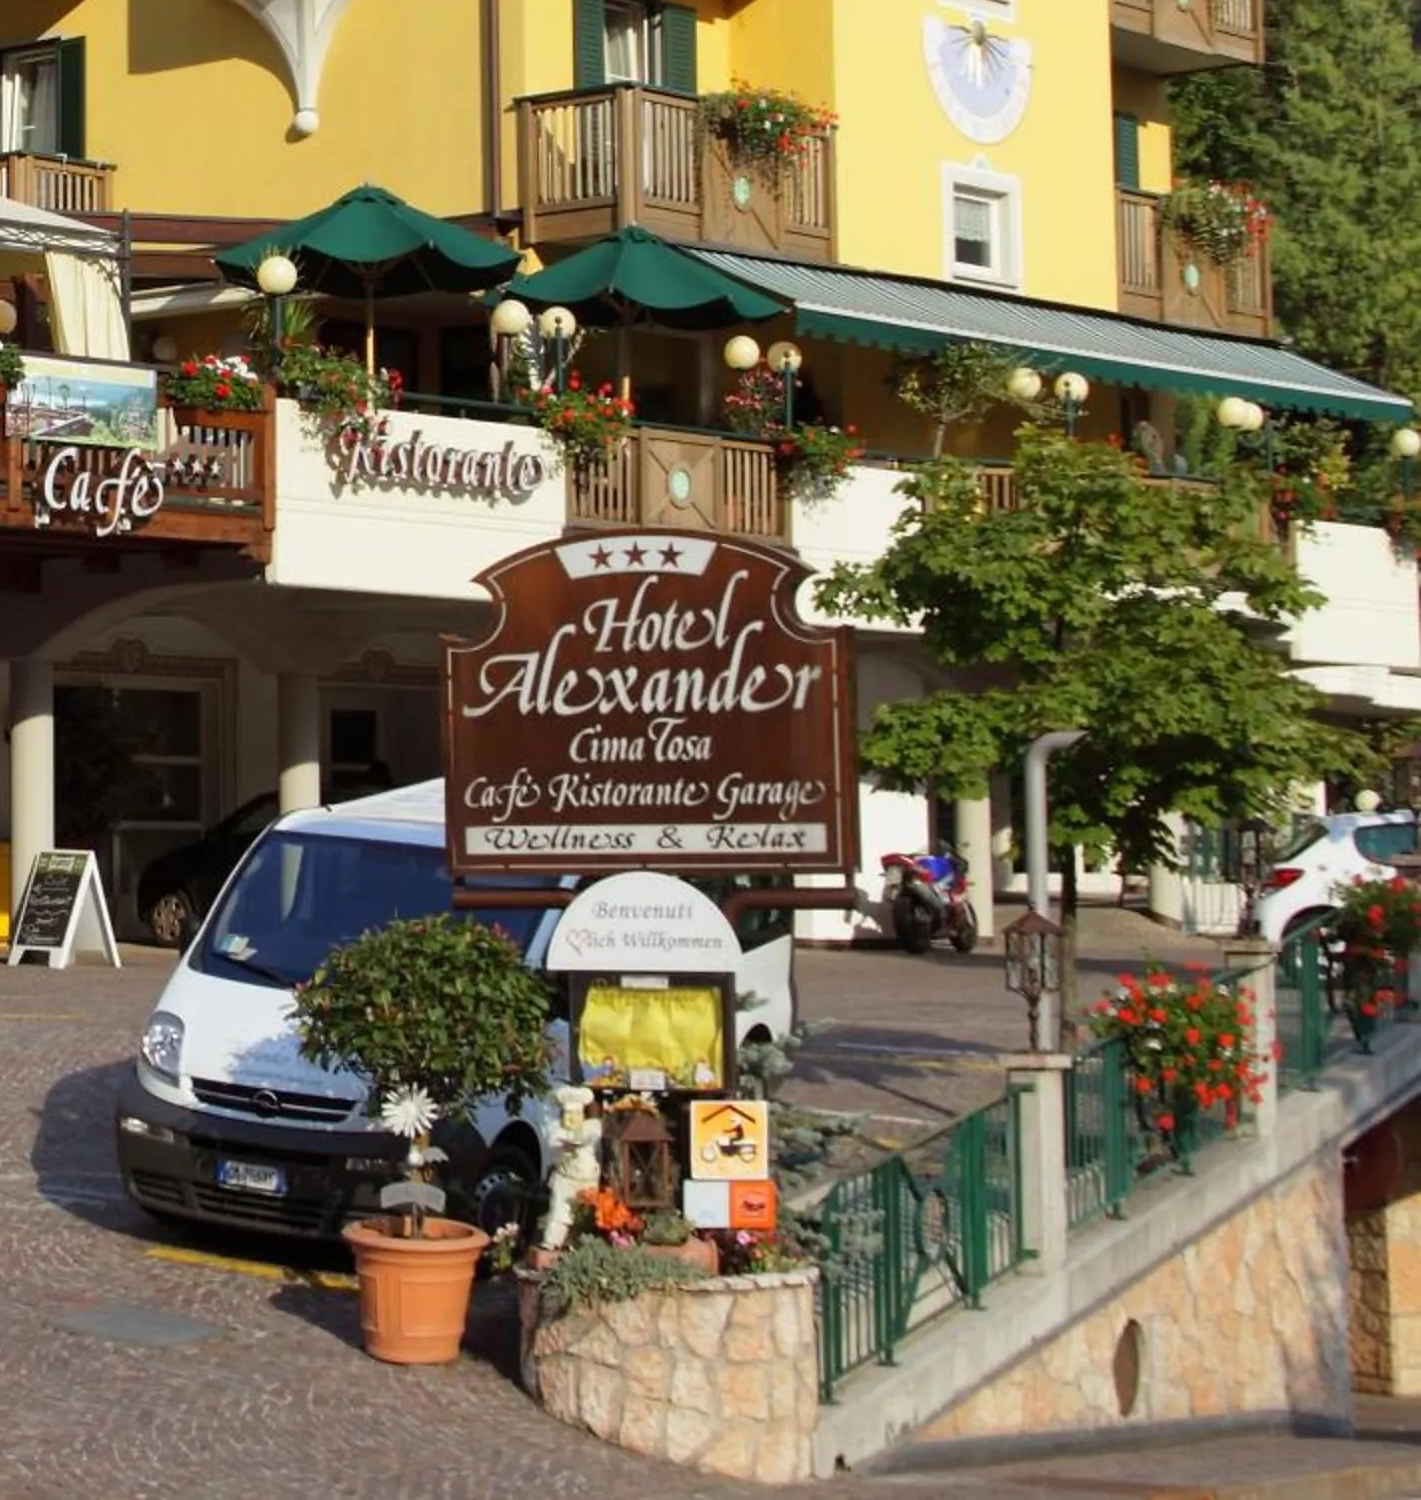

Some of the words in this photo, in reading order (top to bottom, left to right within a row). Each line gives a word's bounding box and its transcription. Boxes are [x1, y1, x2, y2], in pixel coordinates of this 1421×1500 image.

[582, 569, 749, 652] Hotel
[462, 620, 822, 716] Alexander
[569, 724, 645, 763] Cima
[648, 717, 713, 763] Tosa
[547, 772, 709, 812] Ristorante
[712, 772, 826, 821] Garage
[484, 824, 637, 850] Wellness
[656, 826, 683, 849] &
[706, 823, 807, 849] Relax
[592, 900, 693, 919] Benvenuti
[623, 930, 722, 952] Willkommen
